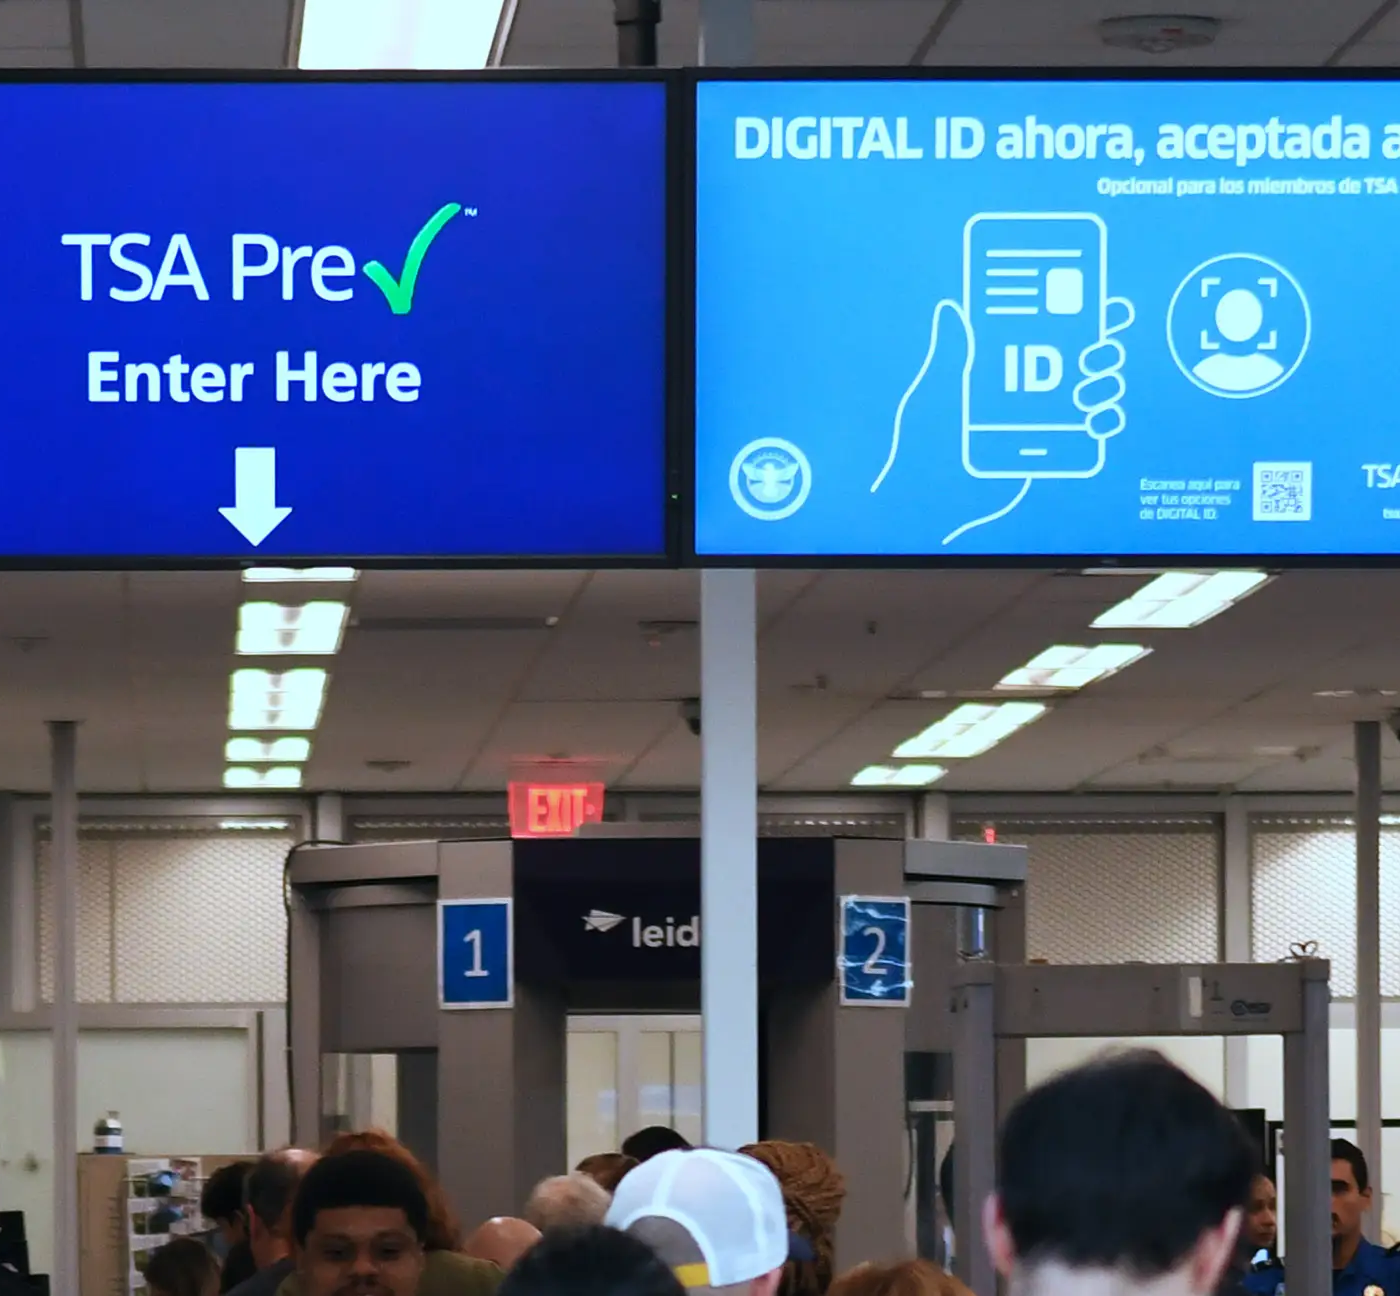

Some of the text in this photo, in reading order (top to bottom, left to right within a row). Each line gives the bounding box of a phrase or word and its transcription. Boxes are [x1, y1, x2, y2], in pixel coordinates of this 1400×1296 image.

[734, 115, 924, 160] DIGITAL
[934, 115, 986, 160] ID
[995, 114, 1146, 167] ahora,
[1156, 115, 1372, 167] aceptada
[1096, 177, 1174, 197] Opcional
[1177, 179, 1216, 198] para
[1219, 177, 1245, 195] los
[1248, 177, 1336, 195] miembros
[1339, 177, 1362, 195] de
[1364, 177, 1398, 195] TSA
[61, 233, 356, 301] TSA Pre
[88, 350, 421, 402] Enter Here
[1004, 344, 1064, 392] ID
[528, 788, 587, 832] EXIT
[463, 929, 489, 977] 1
[632, 915, 700, 948] leid
[863, 926, 887, 974] 2
